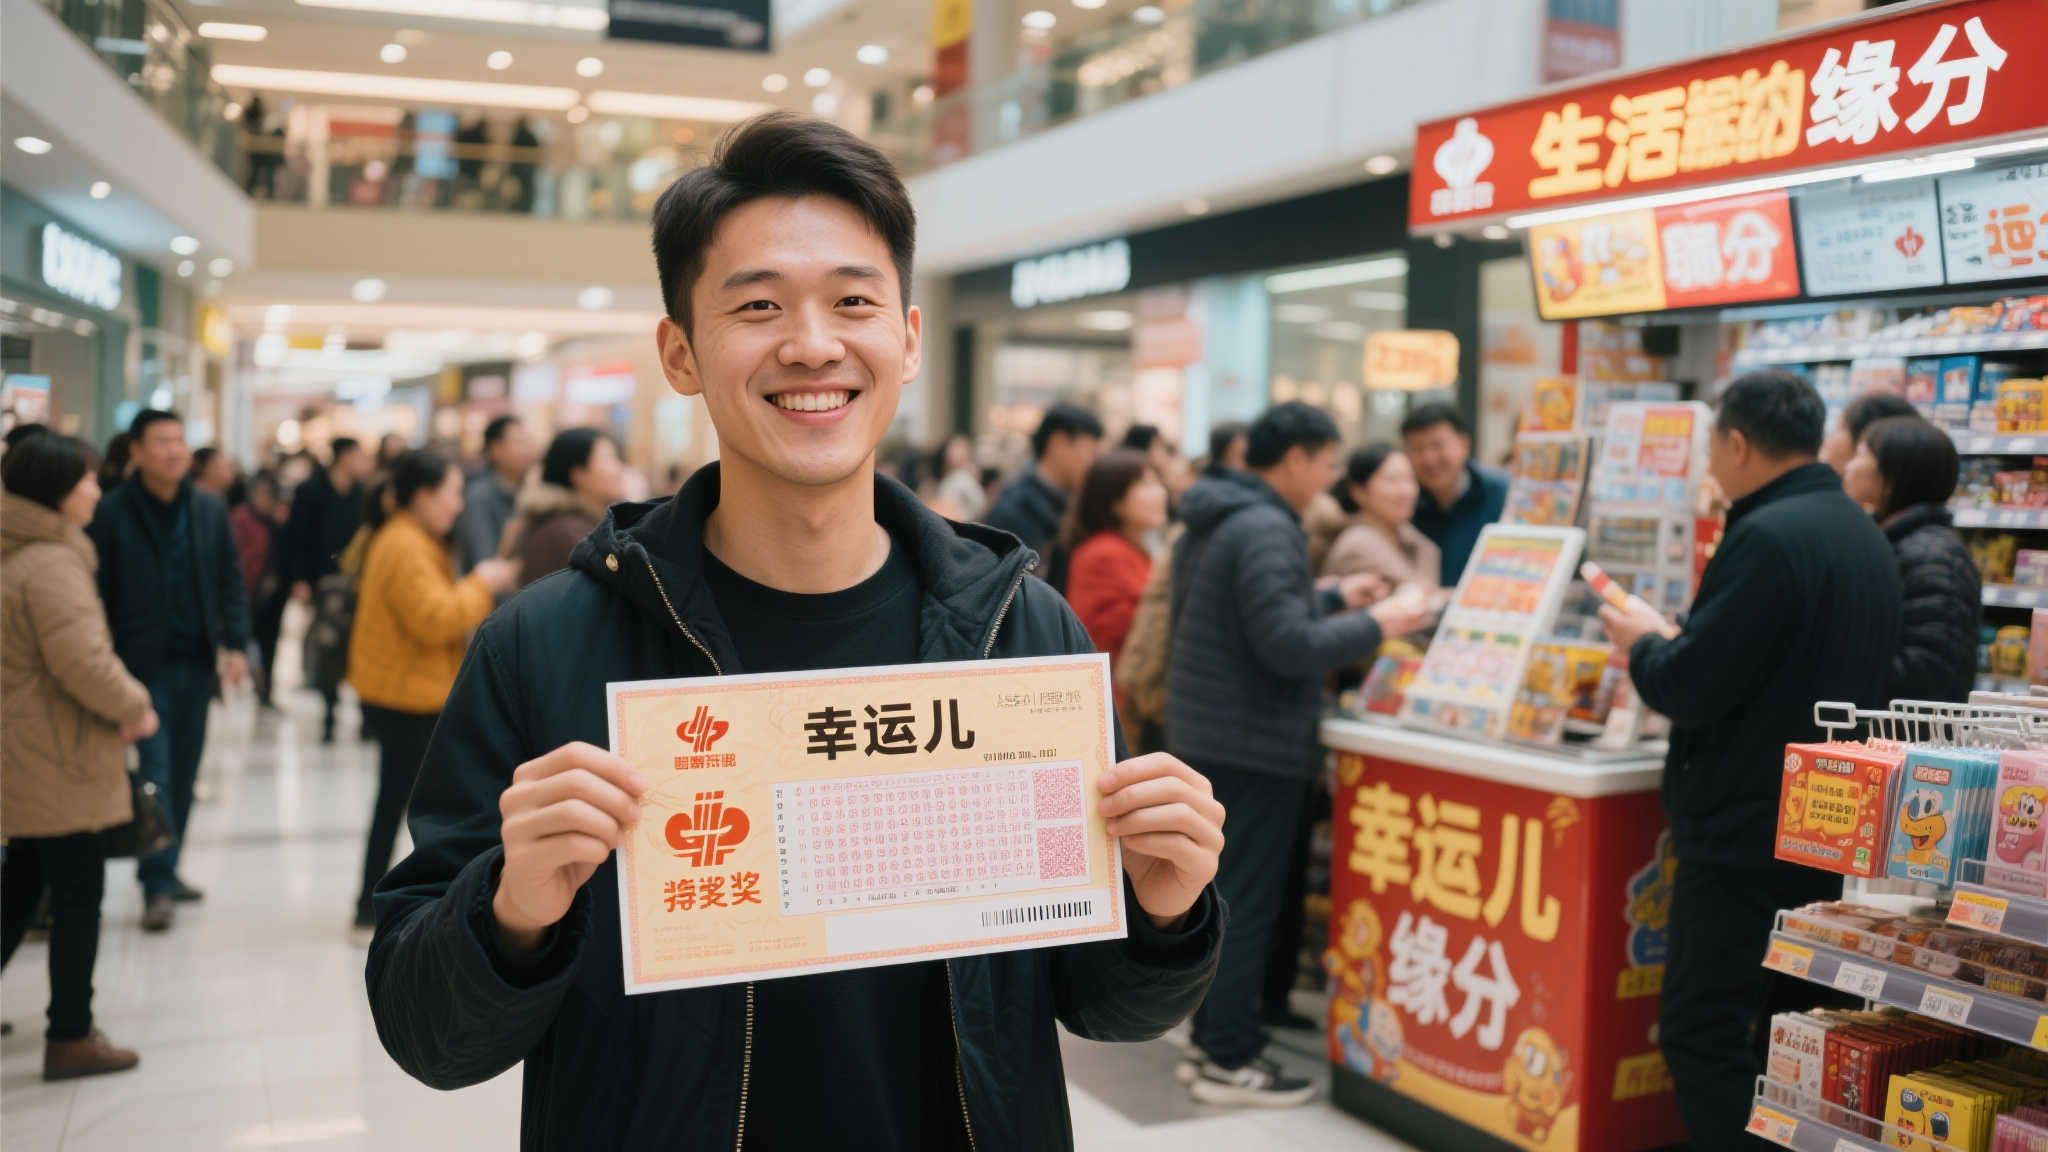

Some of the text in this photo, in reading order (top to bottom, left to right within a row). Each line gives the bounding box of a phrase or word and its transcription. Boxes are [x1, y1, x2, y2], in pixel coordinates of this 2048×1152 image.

[804, 698, 976, 761] 幸运儿
[1349, 781, 1562, 943] 幸运儿
[1387, 910, 1522, 1051] 缘分
